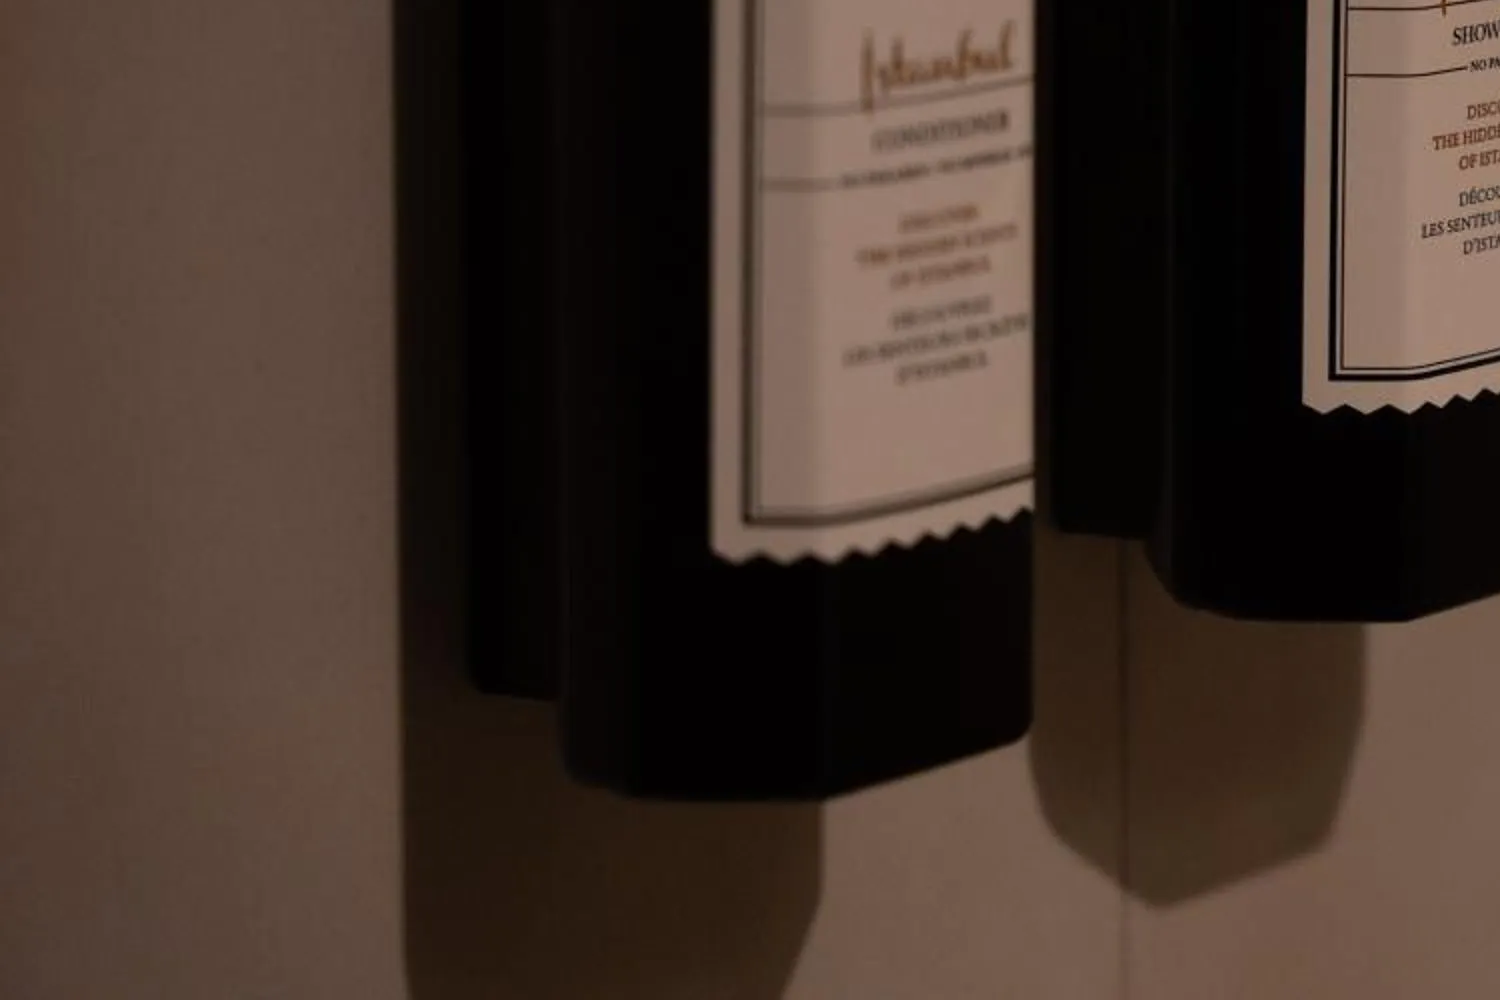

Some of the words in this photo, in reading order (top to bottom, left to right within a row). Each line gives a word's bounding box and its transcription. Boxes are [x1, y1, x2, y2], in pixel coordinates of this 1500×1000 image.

[1470, 59, 1487, 72] NO
[1432, 134, 1461, 151] THE
[1459, 153, 1478, 170] OF
[1421, 223, 1445, 239] LES
